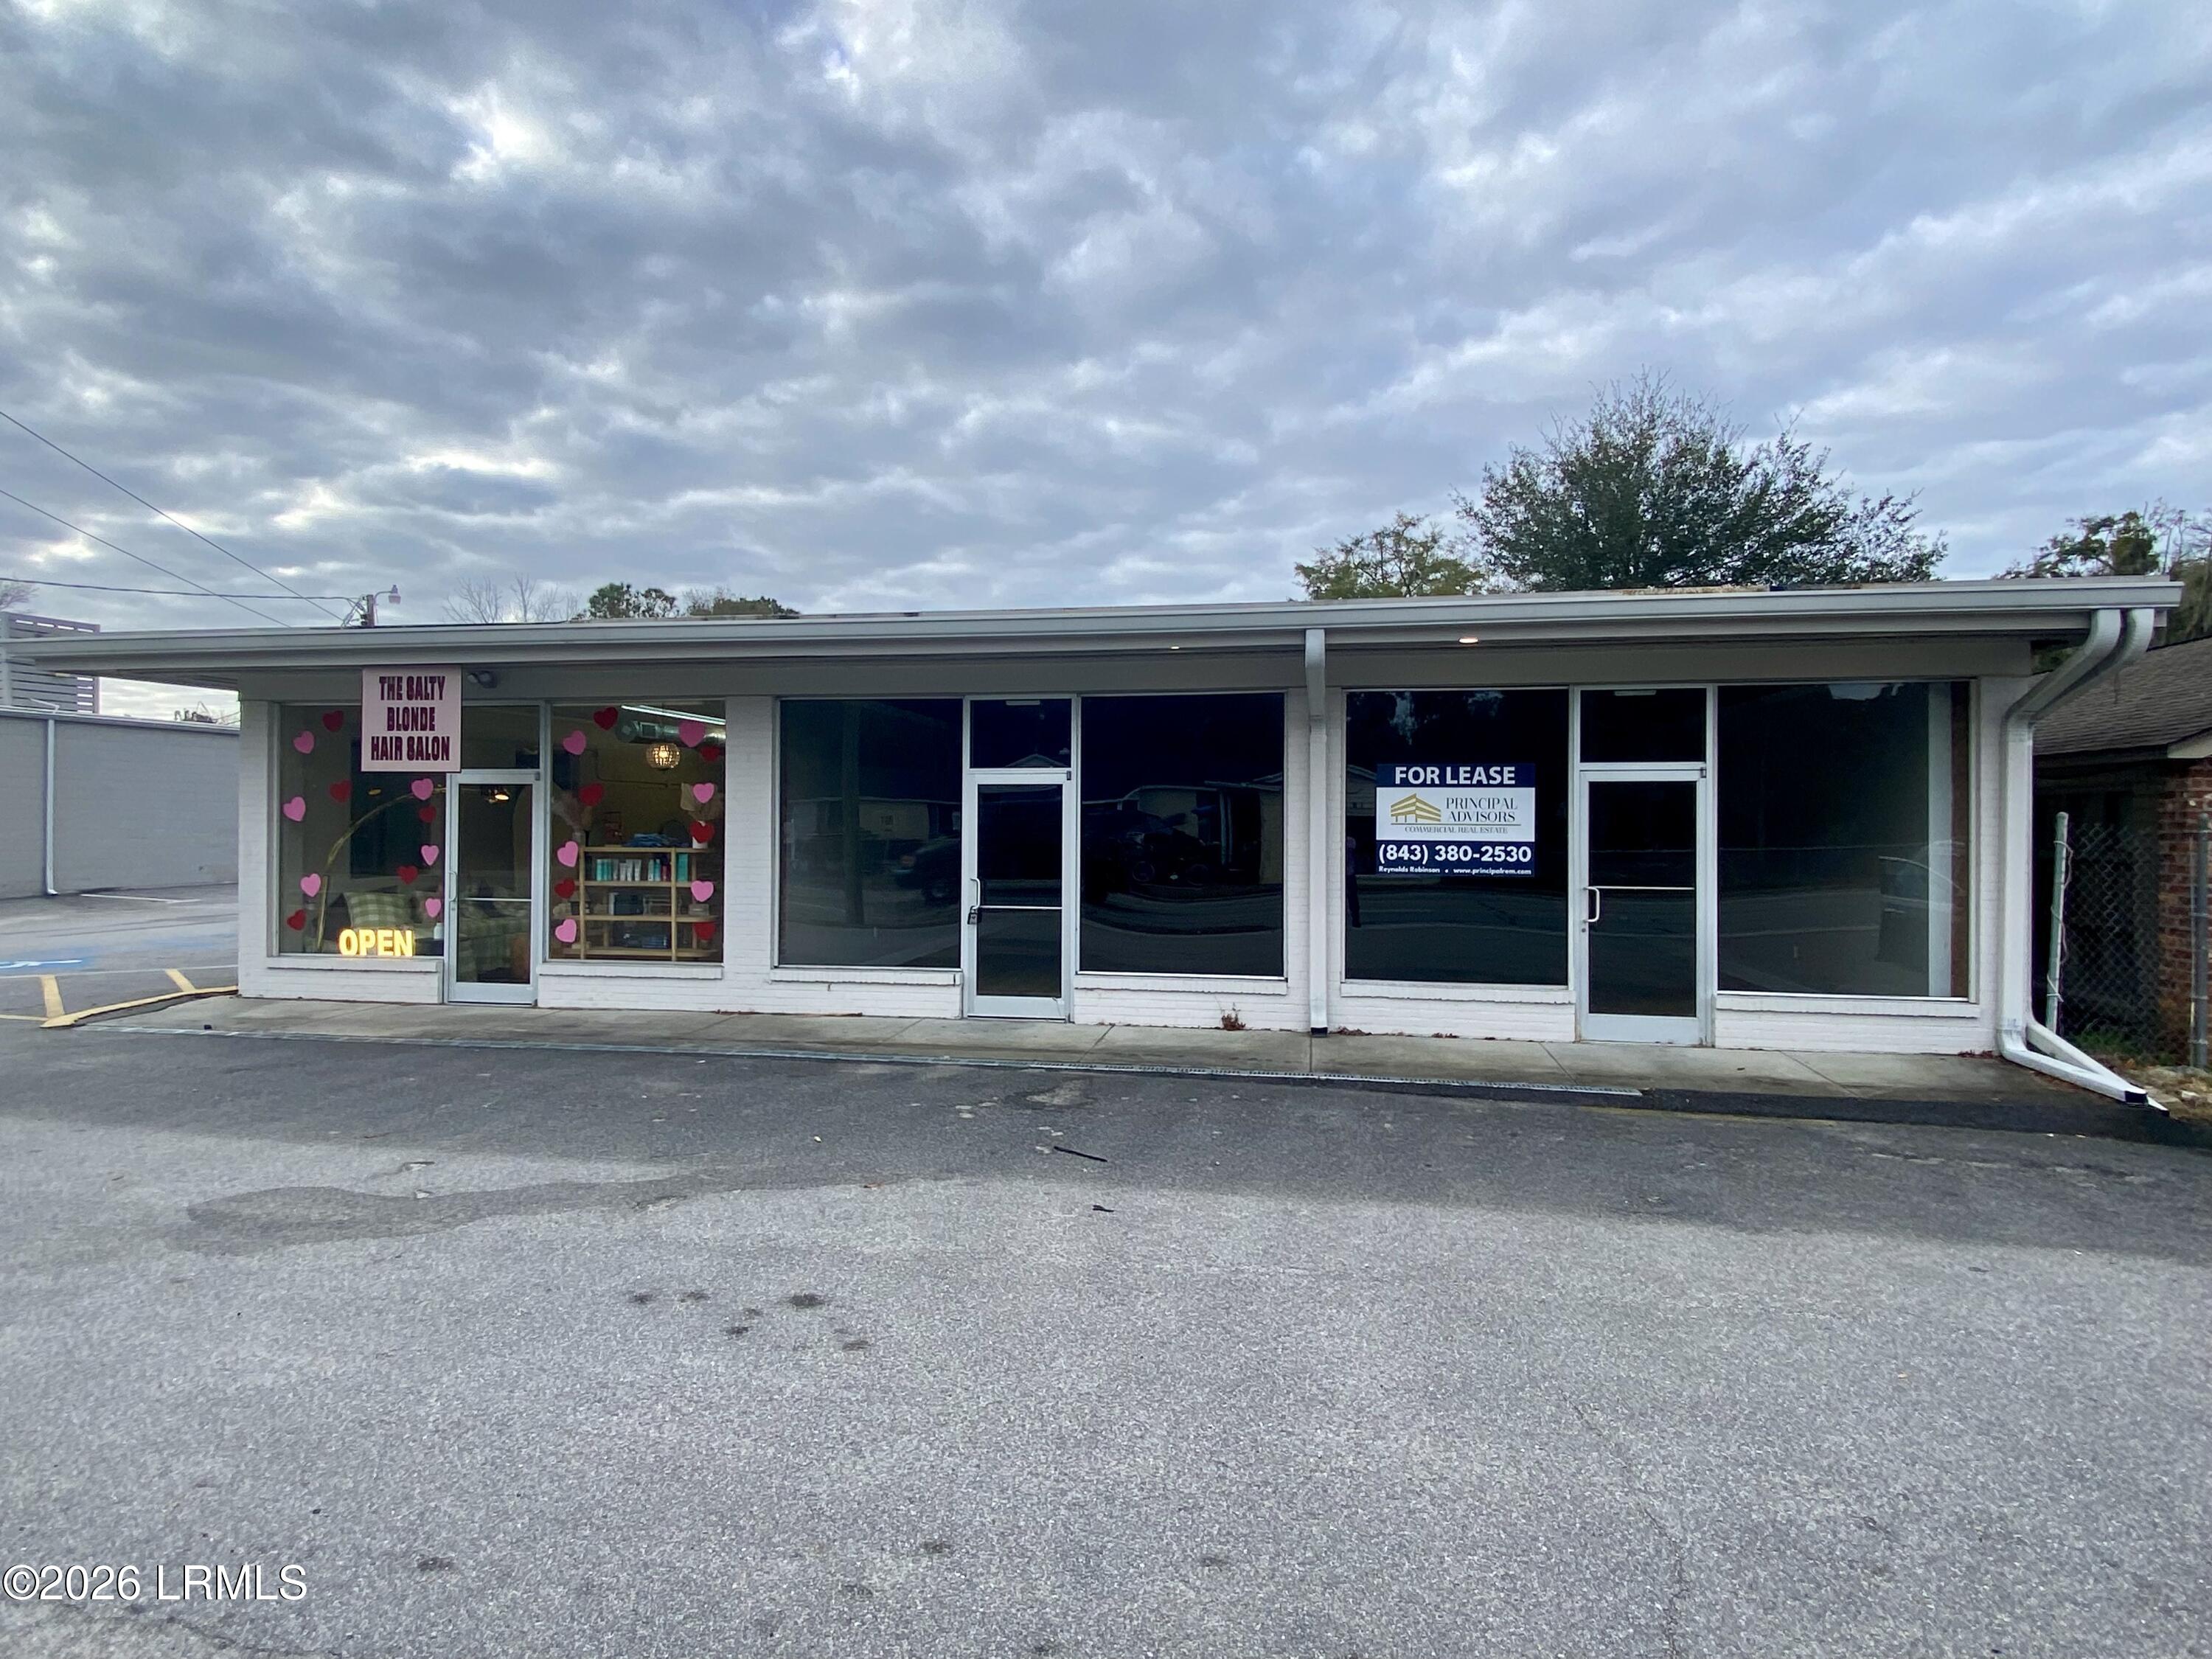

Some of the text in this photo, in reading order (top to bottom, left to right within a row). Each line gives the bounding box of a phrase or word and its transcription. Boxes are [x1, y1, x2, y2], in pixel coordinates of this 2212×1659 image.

[379, 675, 445, 700] THE SALTY
[386, 706, 436, 731] BLONDE
[371, 736, 450, 761] HAIR SALON
[1395, 766, 1516, 785] FOR LEASE
[1446, 797, 1517, 810] PRINCIPAL
[1448, 811, 1516, 823] ADVISORS
[1458, 826, 1479, 834] REAL
[1379, 844, 1532, 864] (843) 380-2530
[1379, 866, 1531, 875] Reynolds Robinson www.principalrem.com
[338, 928, 414, 957] OPEN
